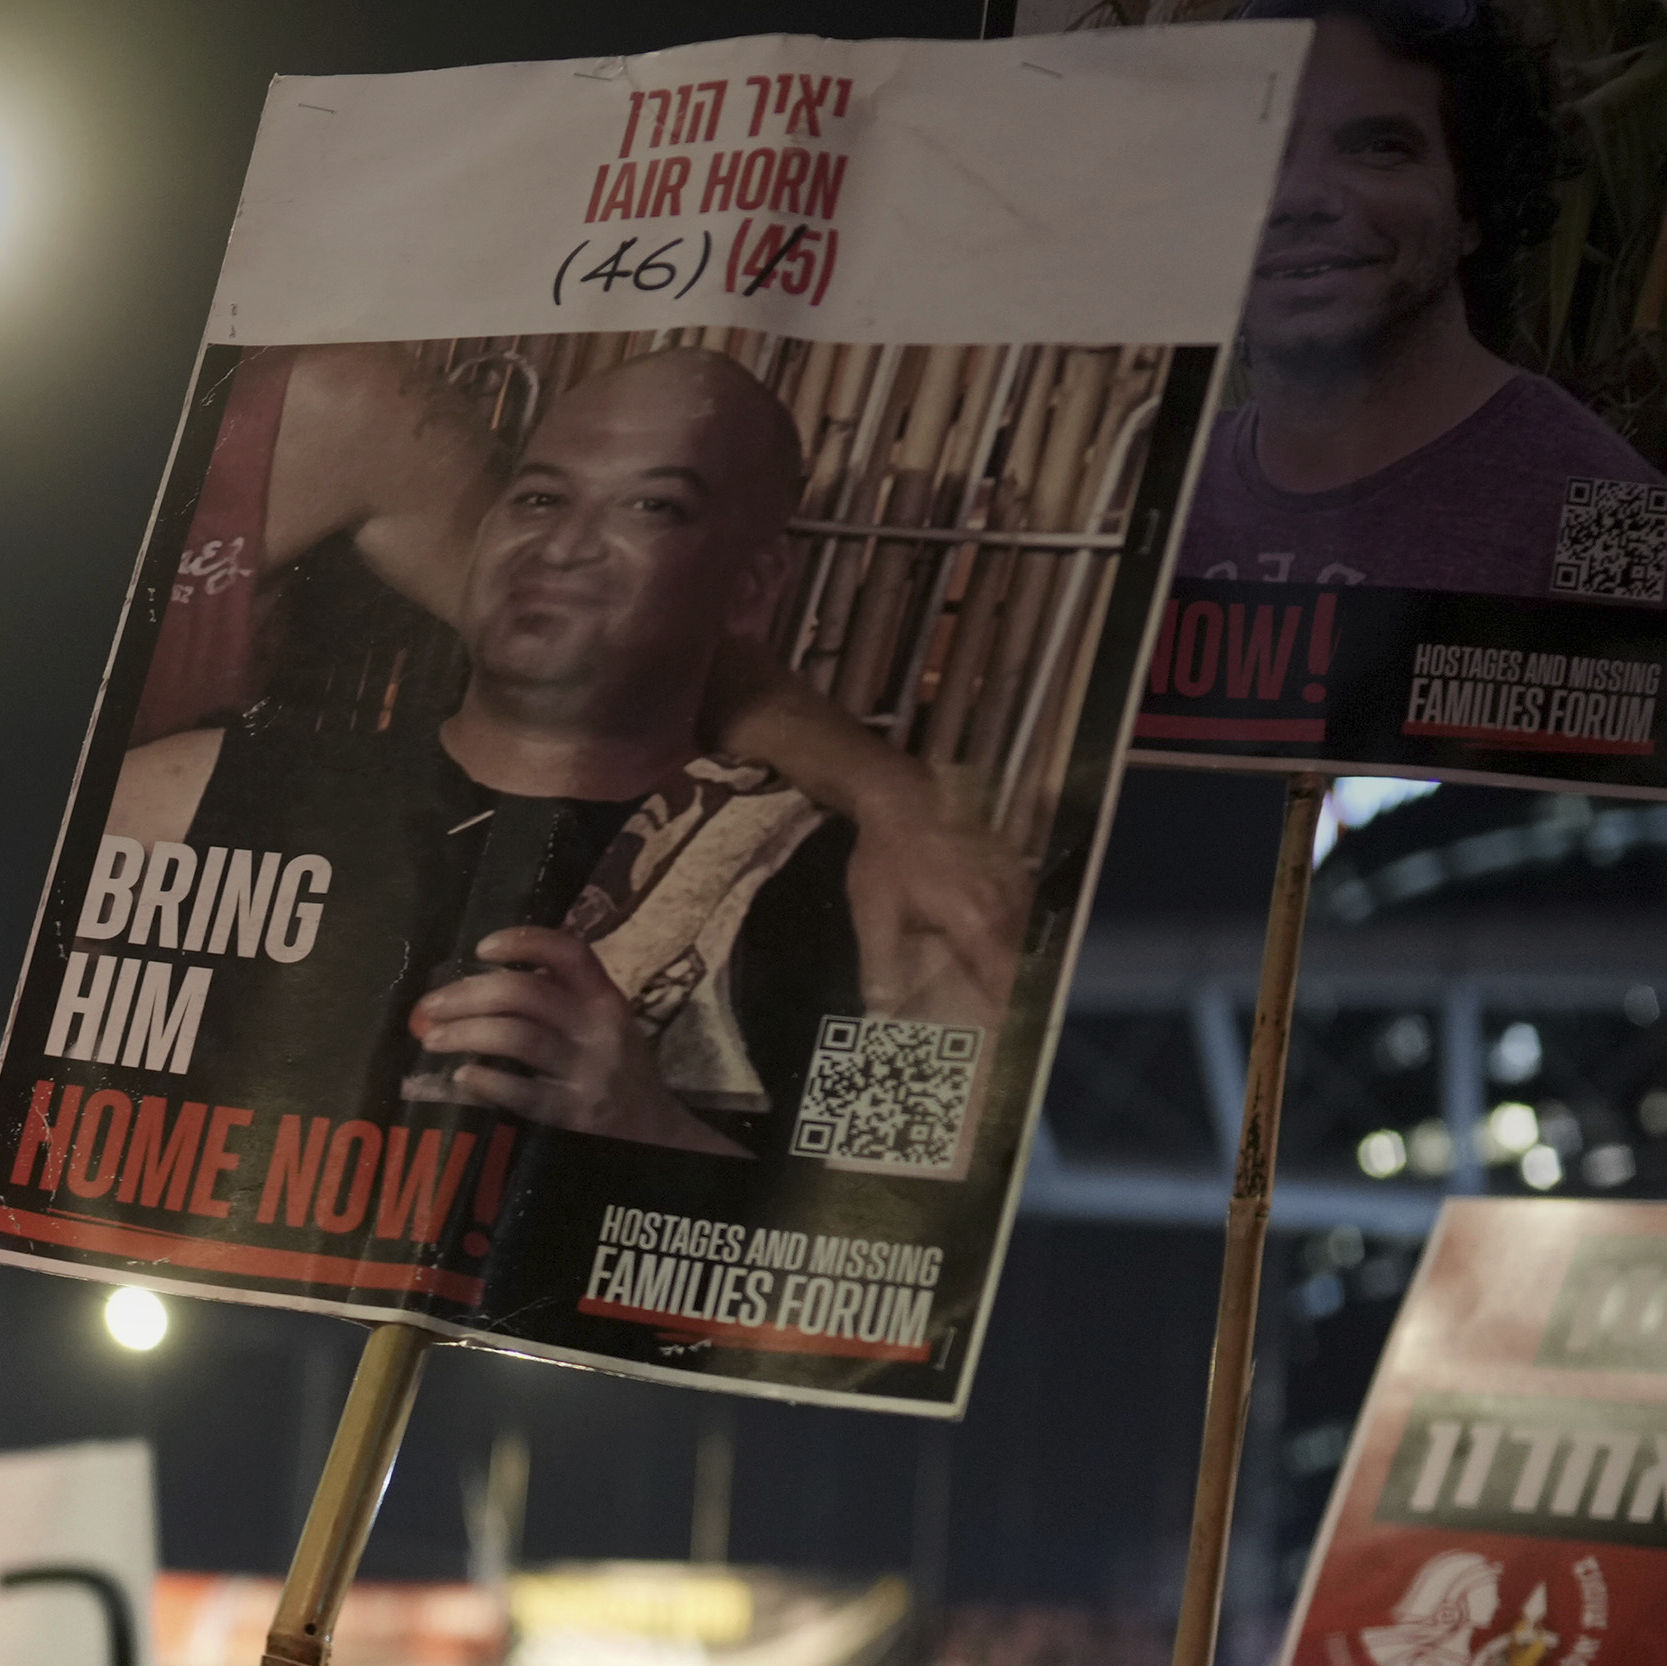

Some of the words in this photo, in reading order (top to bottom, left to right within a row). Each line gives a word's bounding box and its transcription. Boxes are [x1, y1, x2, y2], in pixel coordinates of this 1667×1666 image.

[618, 80, 729, 159] הורן
[746, 73, 853, 137] יאיר
[584, 156, 692, 224] IAIR
[699, 146, 848, 221] HORN
[553, 230, 712, 306] (46)
[724, 217, 839, 307] (45)
[1414, 643, 1522, 682] HOSTAGES
[1524, 651, 1566, 687] AND
[1567, 656, 1663, 695] MISSING
[1407, 677, 1545, 734] FAMILIES
[1547, 689, 1656, 743] FORUM
[75, 834, 333, 963] BRING
[43, 950, 214, 1076] HIM
[9, 1078, 255, 1219] HOME
[255, 1112, 517, 1257] NOW!
[599, 1204, 746, 1264] HOSTAGES
[744, 1227, 809, 1271] AND
[806, 1235, 945, 1288] MISSING
[585, 1245, 774, 1328] FAMILIES
[776, 1274, 934, 1348] FORUM
